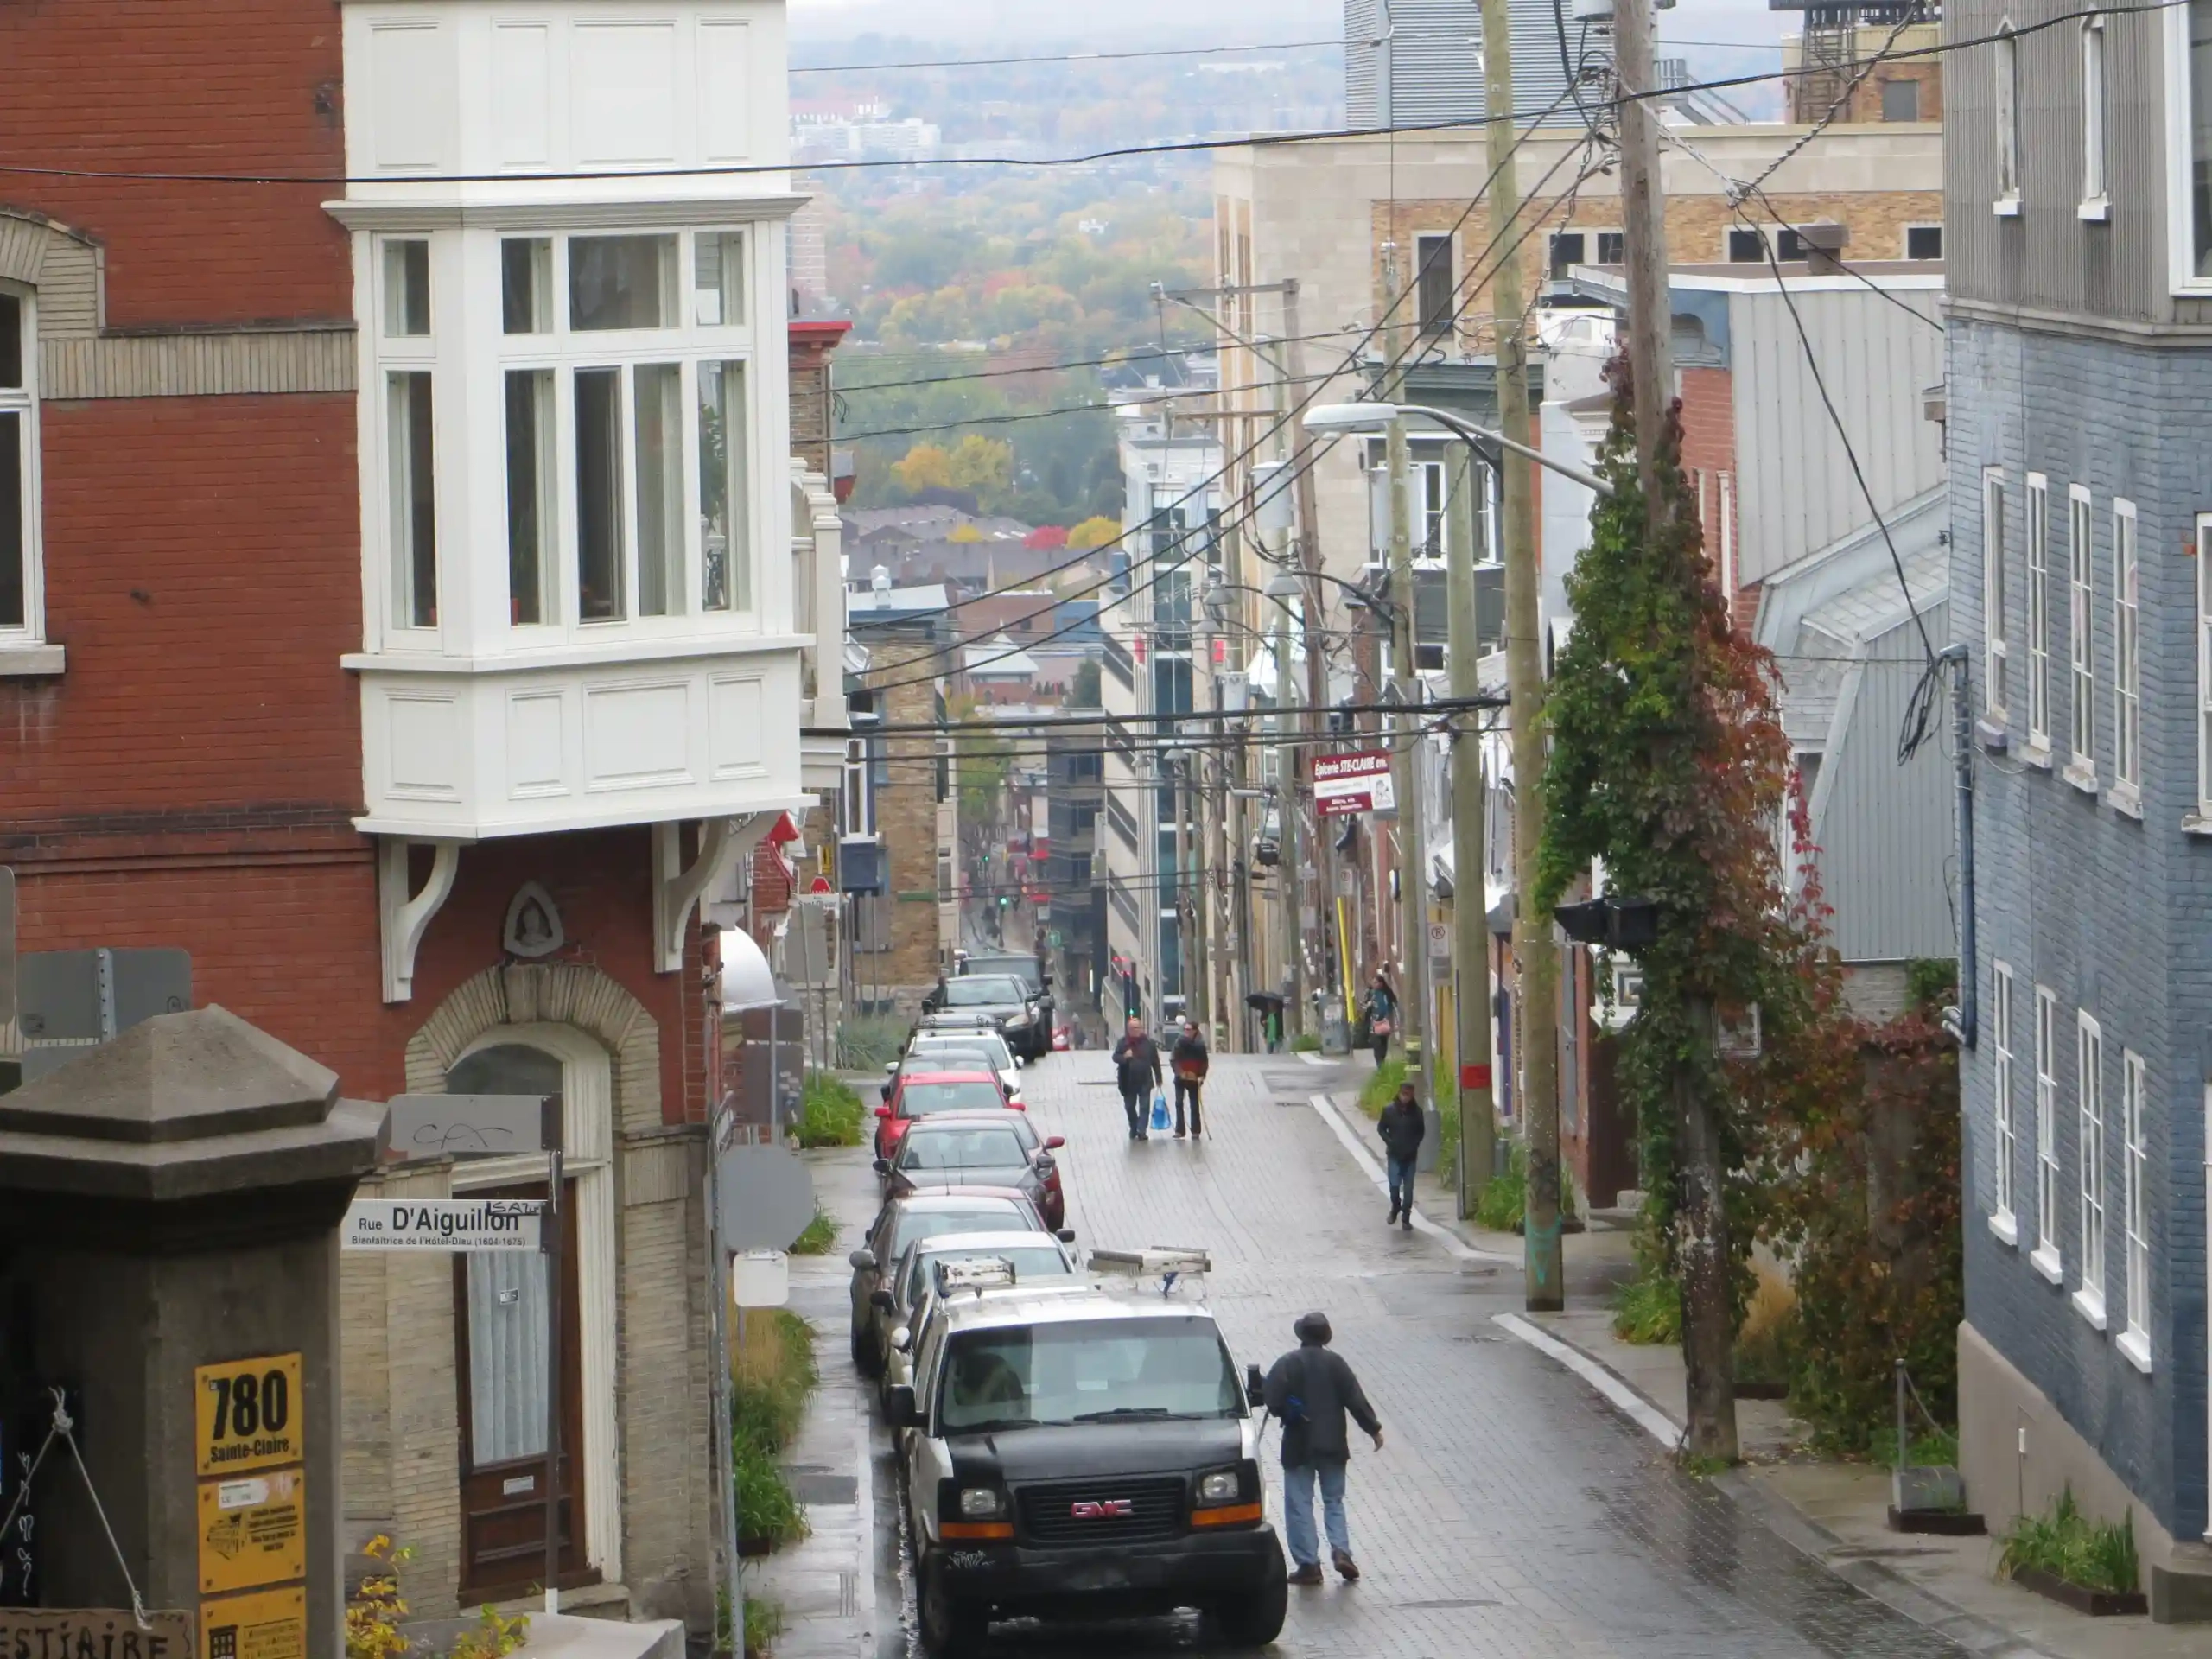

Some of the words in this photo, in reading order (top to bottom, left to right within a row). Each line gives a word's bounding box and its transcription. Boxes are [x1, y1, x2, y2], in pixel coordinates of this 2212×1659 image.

[1340, 756, 1376, 773] STE-CLAIRE
[359, 1218, 383, 1230] Rue
[392, 1207, 518, 1236] D'Aiguillon
[352, 1236, 404, 1245] Bienfaitrice
[405, 1236, 416, 1245] de
[209, 1370, 288, 1440] 780
[211, 1438, 289, 1463] Sainte-Claire
[1071, 1499, 1133, 1518] GMC
